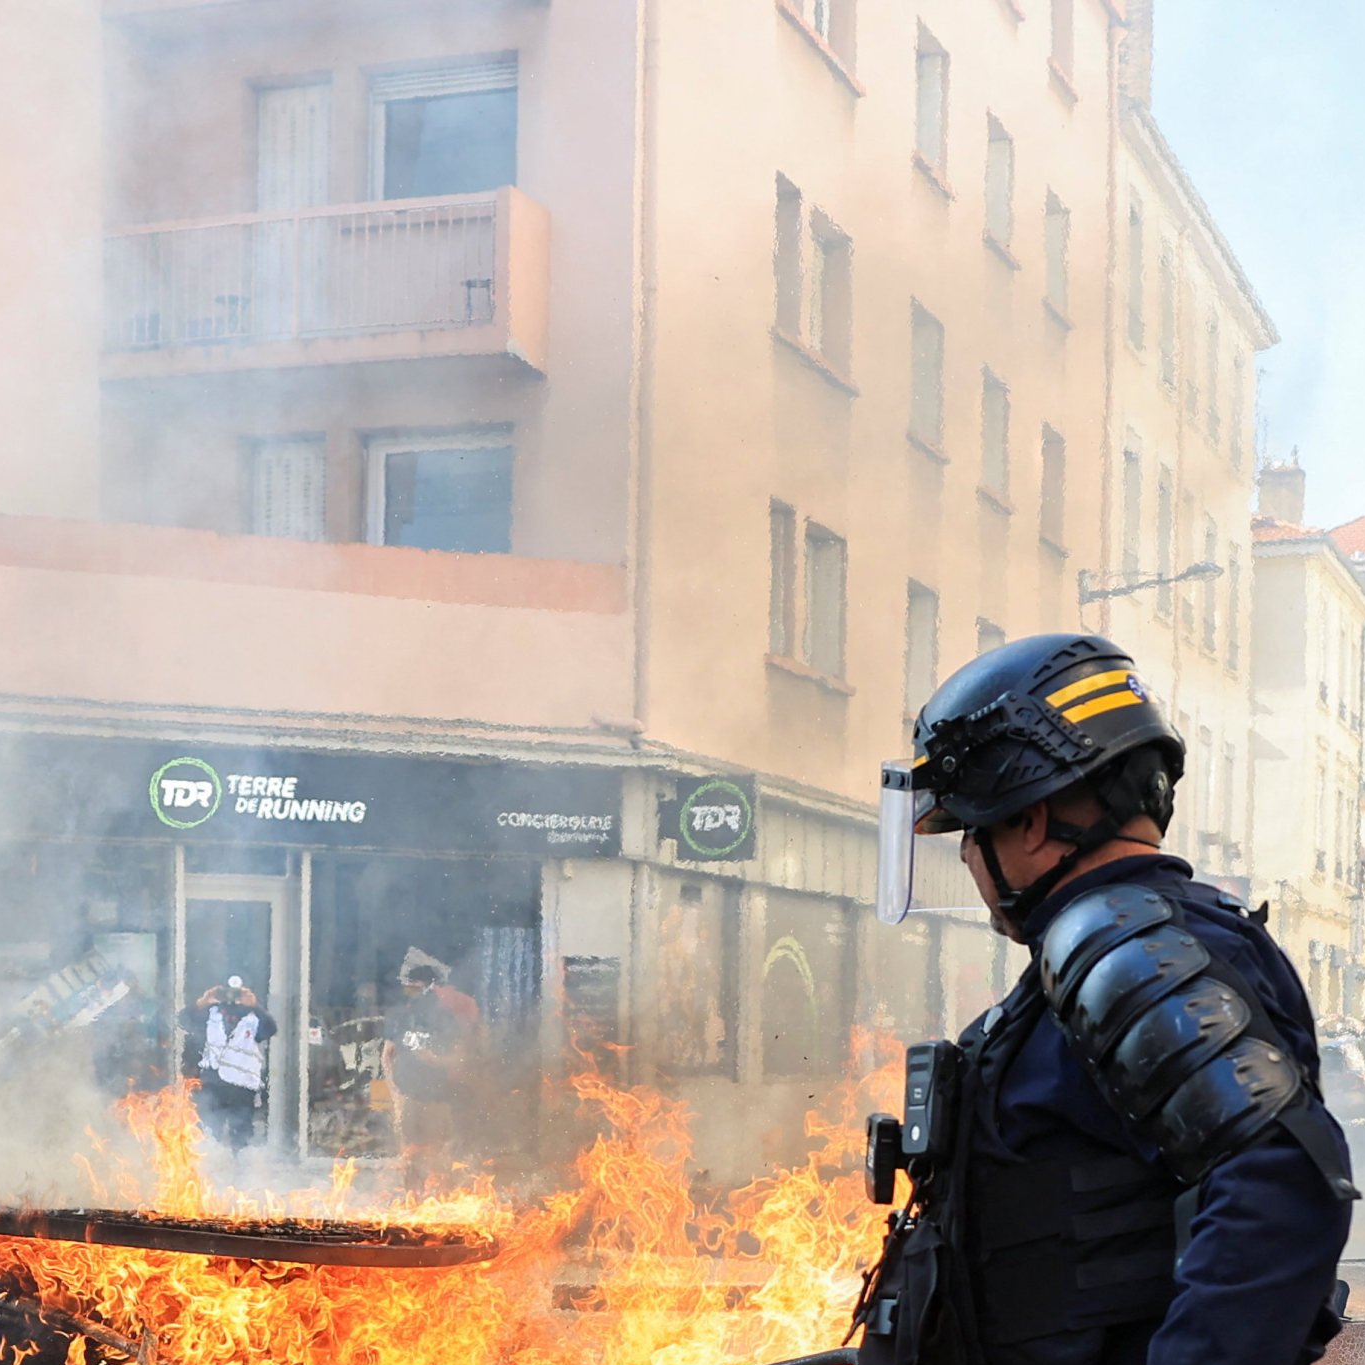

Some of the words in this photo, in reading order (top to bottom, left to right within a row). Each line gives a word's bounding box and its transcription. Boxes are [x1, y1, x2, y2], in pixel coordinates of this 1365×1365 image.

[160, 779, 214, 807] TDR
[226, 774, 298, 799] TERRE
[235, 797, 258, 814] DE
[689, 804, 742, 831] TDR
